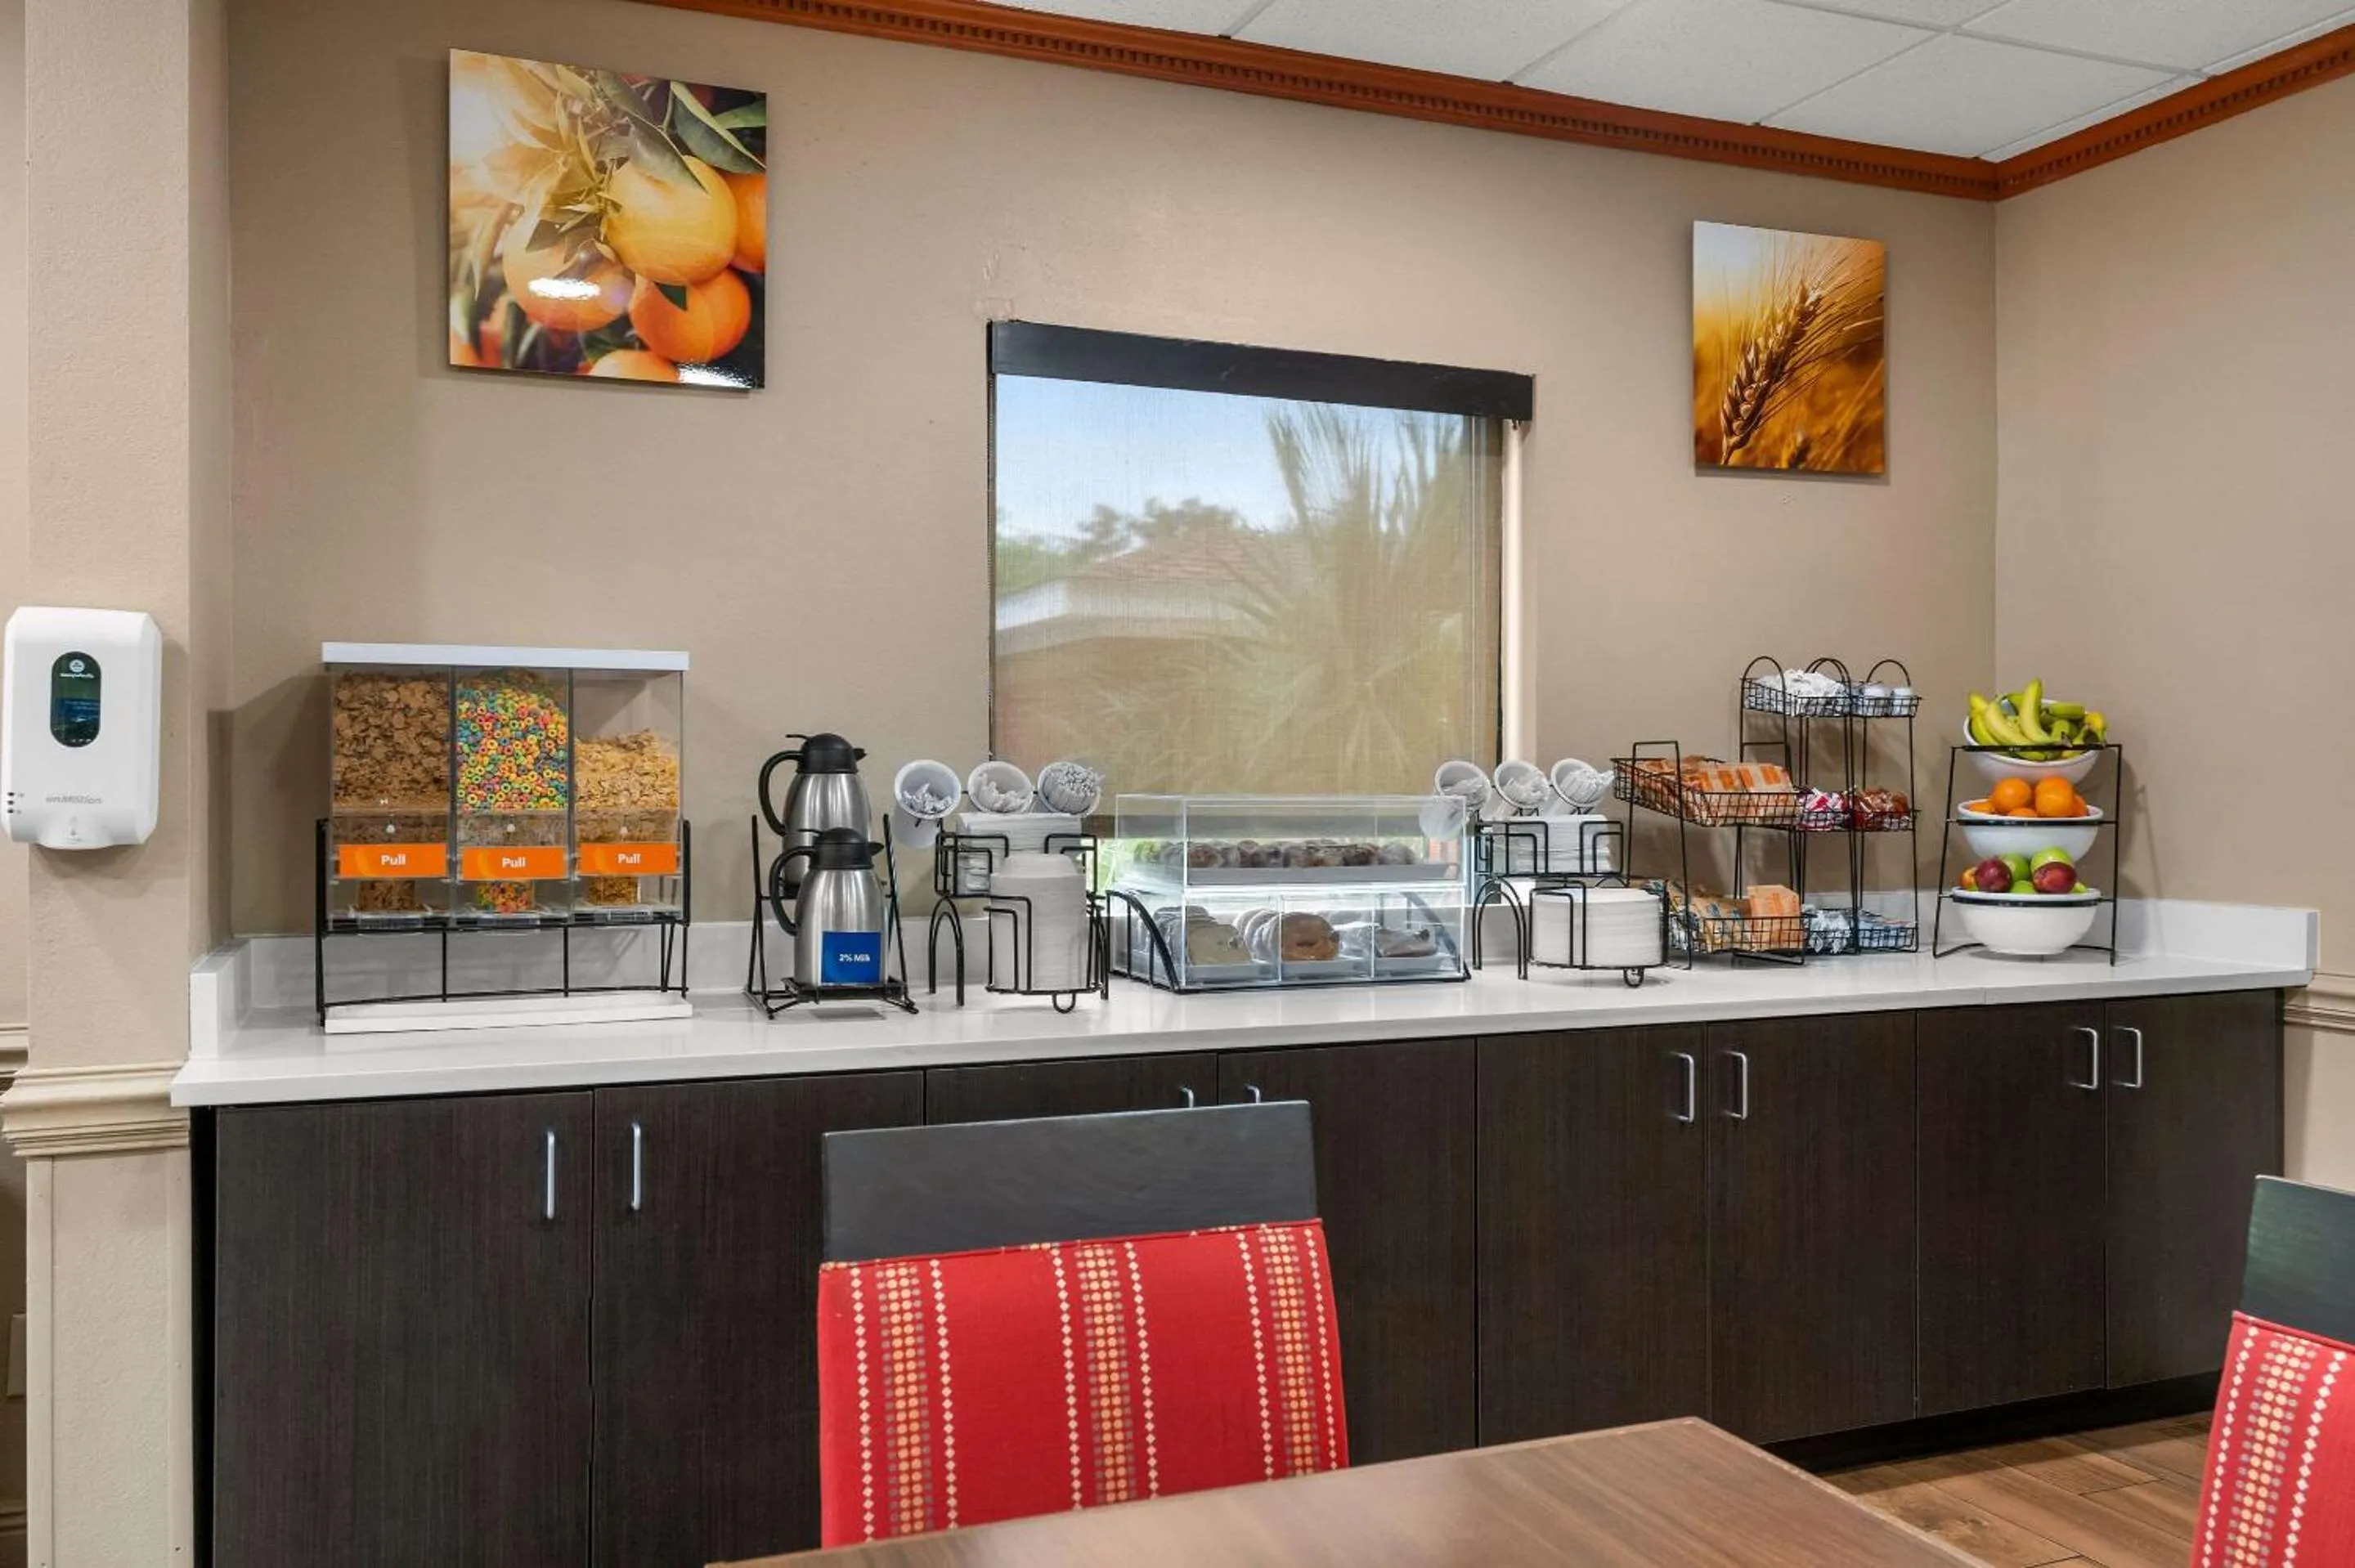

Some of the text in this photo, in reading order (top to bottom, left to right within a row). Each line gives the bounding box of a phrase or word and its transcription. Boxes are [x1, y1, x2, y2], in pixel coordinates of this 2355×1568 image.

[380, 853, 406, 866] Pull
[501, 856, 527, 868] Pull
[617, 853, 641, 864] Pull
[839, 953, 870, 961] 2% Milk
